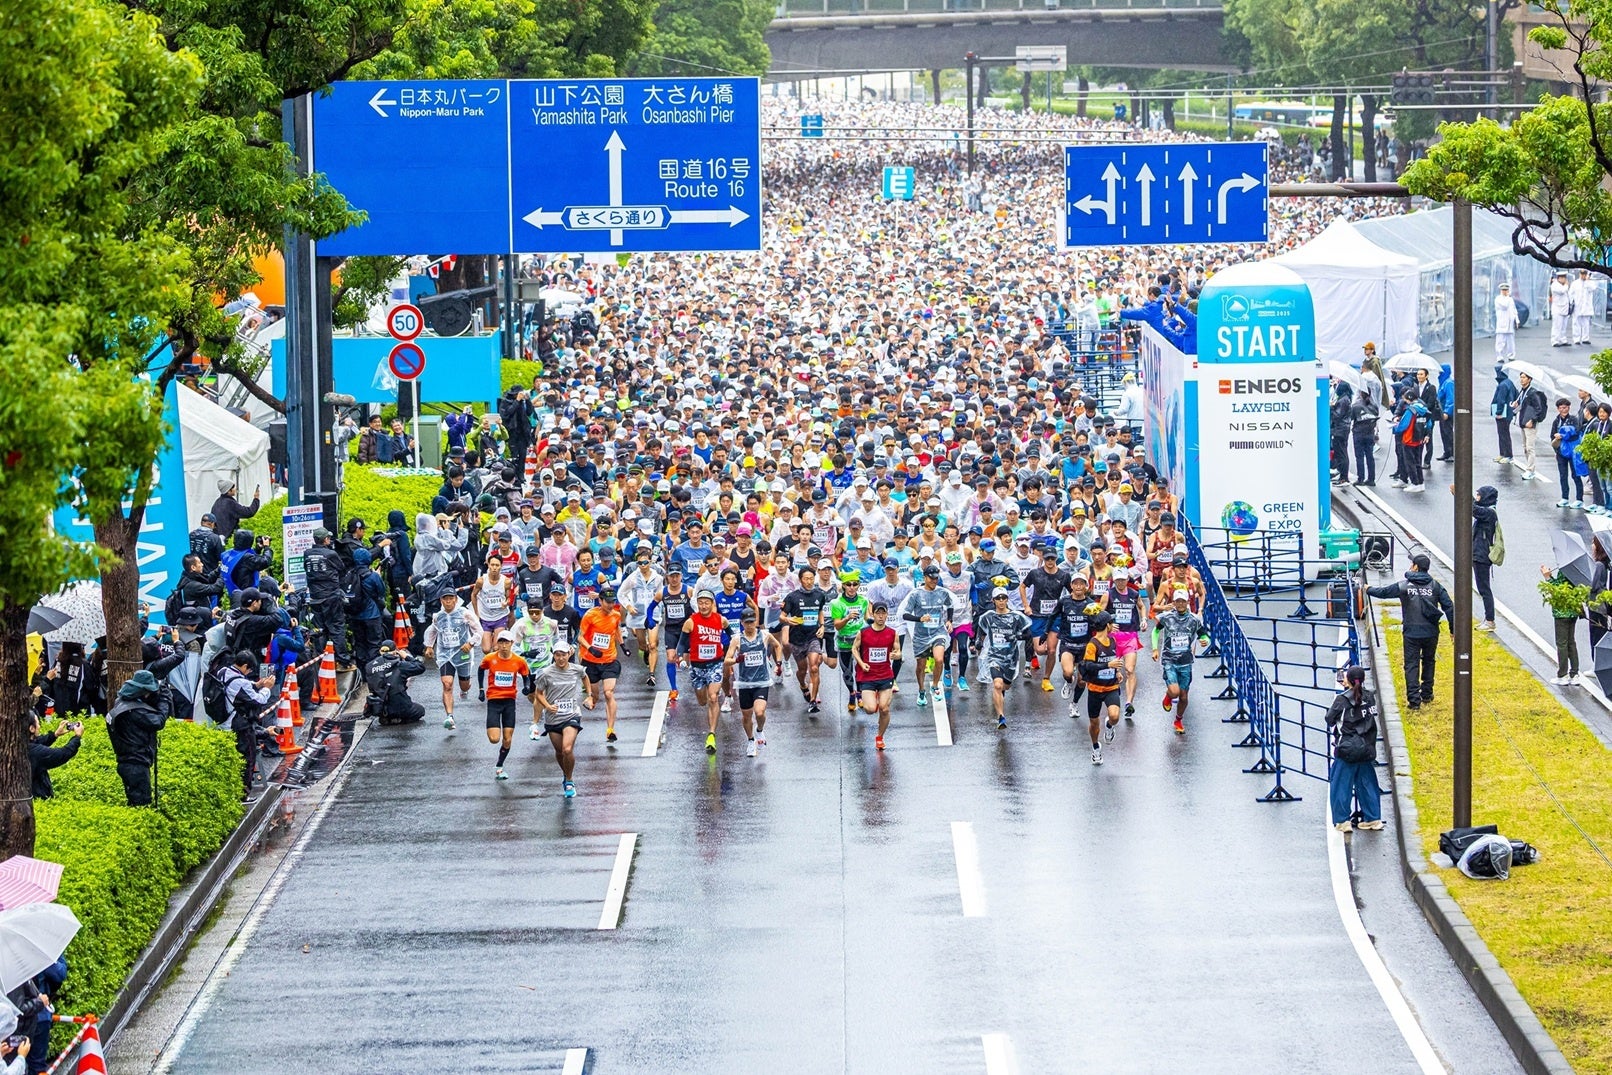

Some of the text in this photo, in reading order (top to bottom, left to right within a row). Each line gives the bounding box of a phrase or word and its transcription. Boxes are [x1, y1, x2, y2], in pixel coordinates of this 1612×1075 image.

[401, 88, 500, 105] 日本丸パーク
[535, 84, 734, 106] 山下公園 大さん橋
[400, 107, 485, 118] Nippon-Maru Park
[532, 107, 628, 125] Yamashita Park
[642, 105, 735, 124] Osanbashi Pier
[659, 158, 751, 180] 国道16号
[665, 180, 745, 198] Route 16
[890, 174, 908, 194] E
[576, 209, 657, 226] さくら通り
[394, 315, 416, 331] 50
[1217, 324, 1300, 358] START
[1234, 378, 1302, 394] ENEOS
[1231, 402, 1291, 413] LAWSON
[1229, 422, 1294, 431] NISSAN
[1263, 502, 1304, 513] GREEN
[1268, 519, 1302, 530] EXPO
